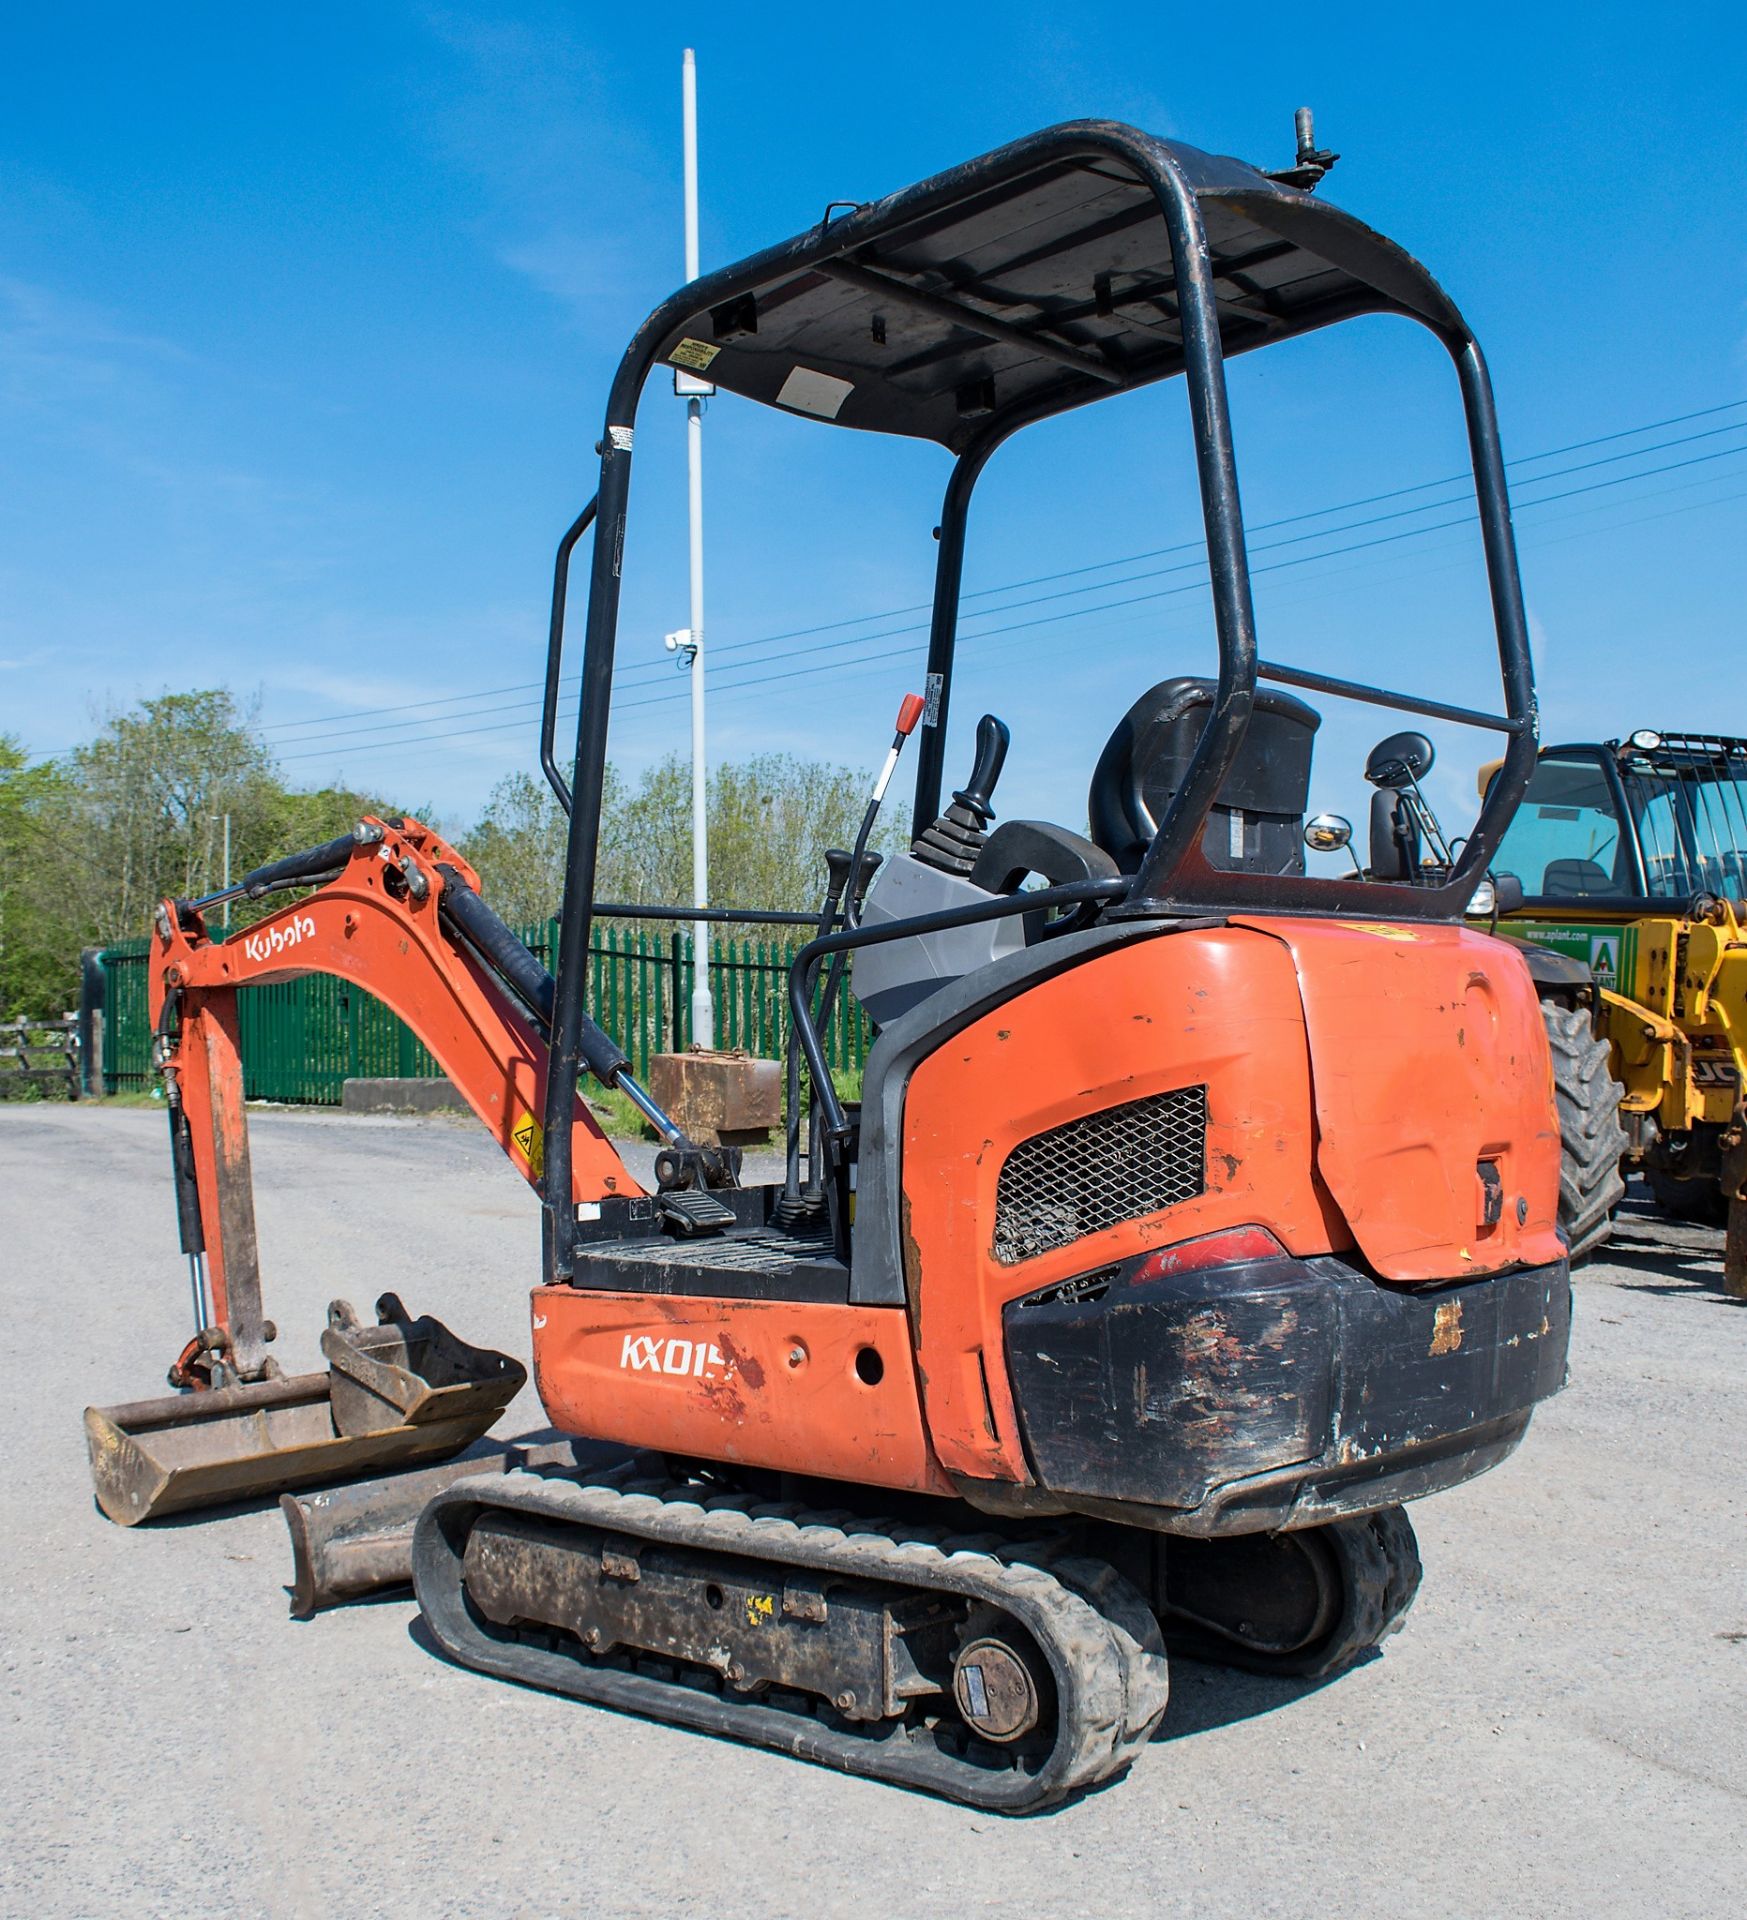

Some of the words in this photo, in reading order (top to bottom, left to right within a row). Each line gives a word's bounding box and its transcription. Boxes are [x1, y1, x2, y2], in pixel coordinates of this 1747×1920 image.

[244, 915, 316, 962] Kubota
[1526, 929, 1589, 943] www.aplant.com
[1698, 1061, 1737, 1082] JC
